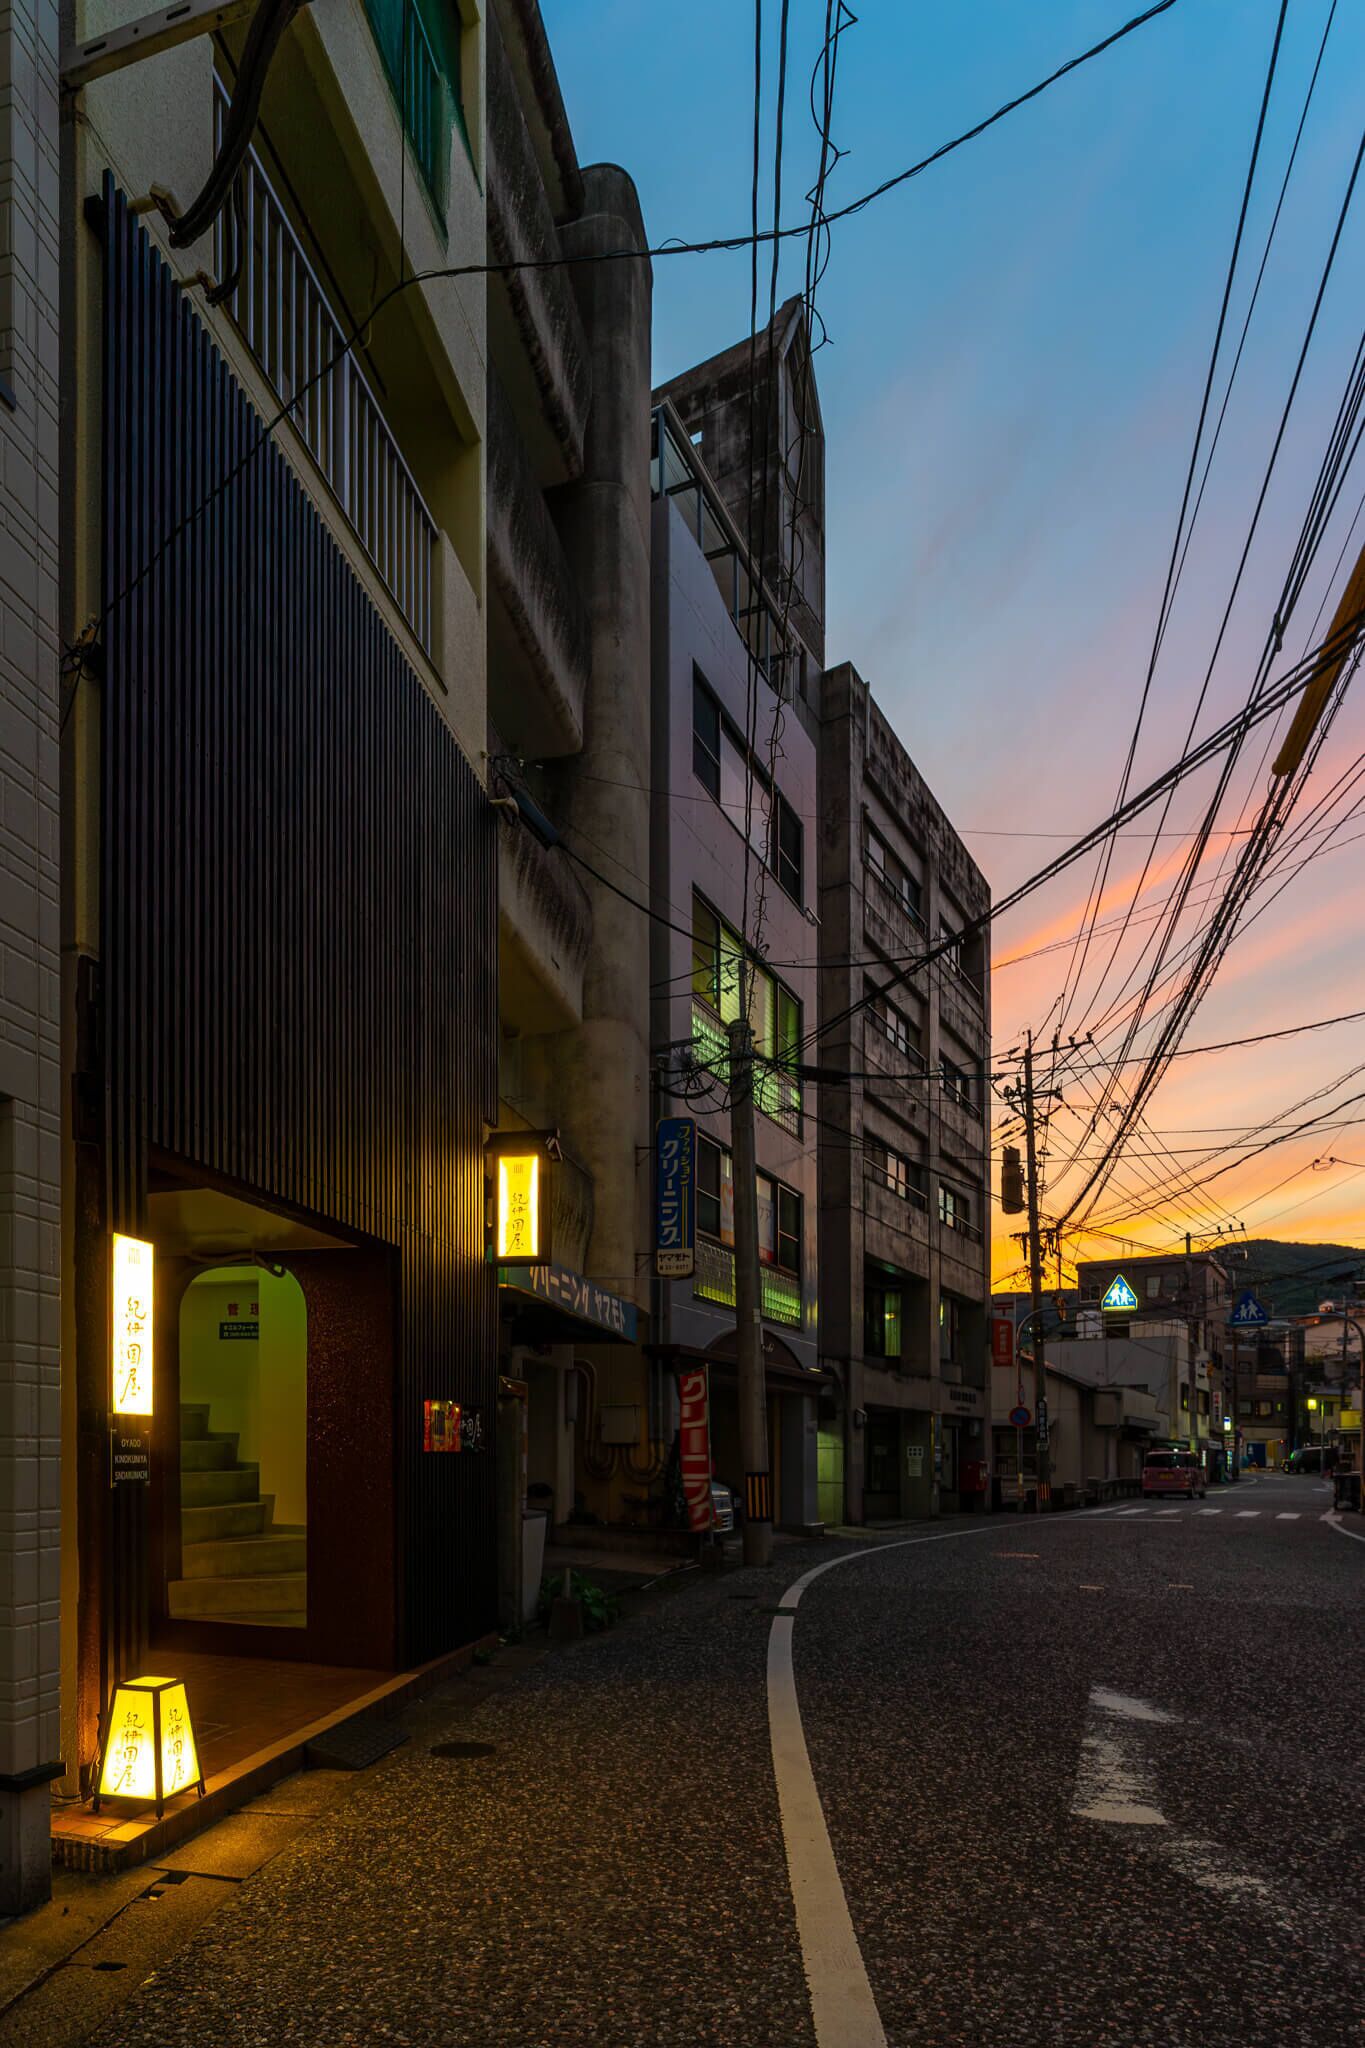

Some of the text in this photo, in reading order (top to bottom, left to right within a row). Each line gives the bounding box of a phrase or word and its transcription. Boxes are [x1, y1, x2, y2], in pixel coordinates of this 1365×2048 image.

[659, 1139, 681, 1246] クリーニング
[506, 1193, 528, 1255] 紀伊国屋
[658, 1253, 690, 1263] ヤマモト
[594, 1289, 625, 1334] ヤマモト
[119, 1295, 147, 1404] 紀伊国屋
[121, 1438, 141, 1448] OYADO
[114, 1711, 145, 1792] 紀伊国屋
